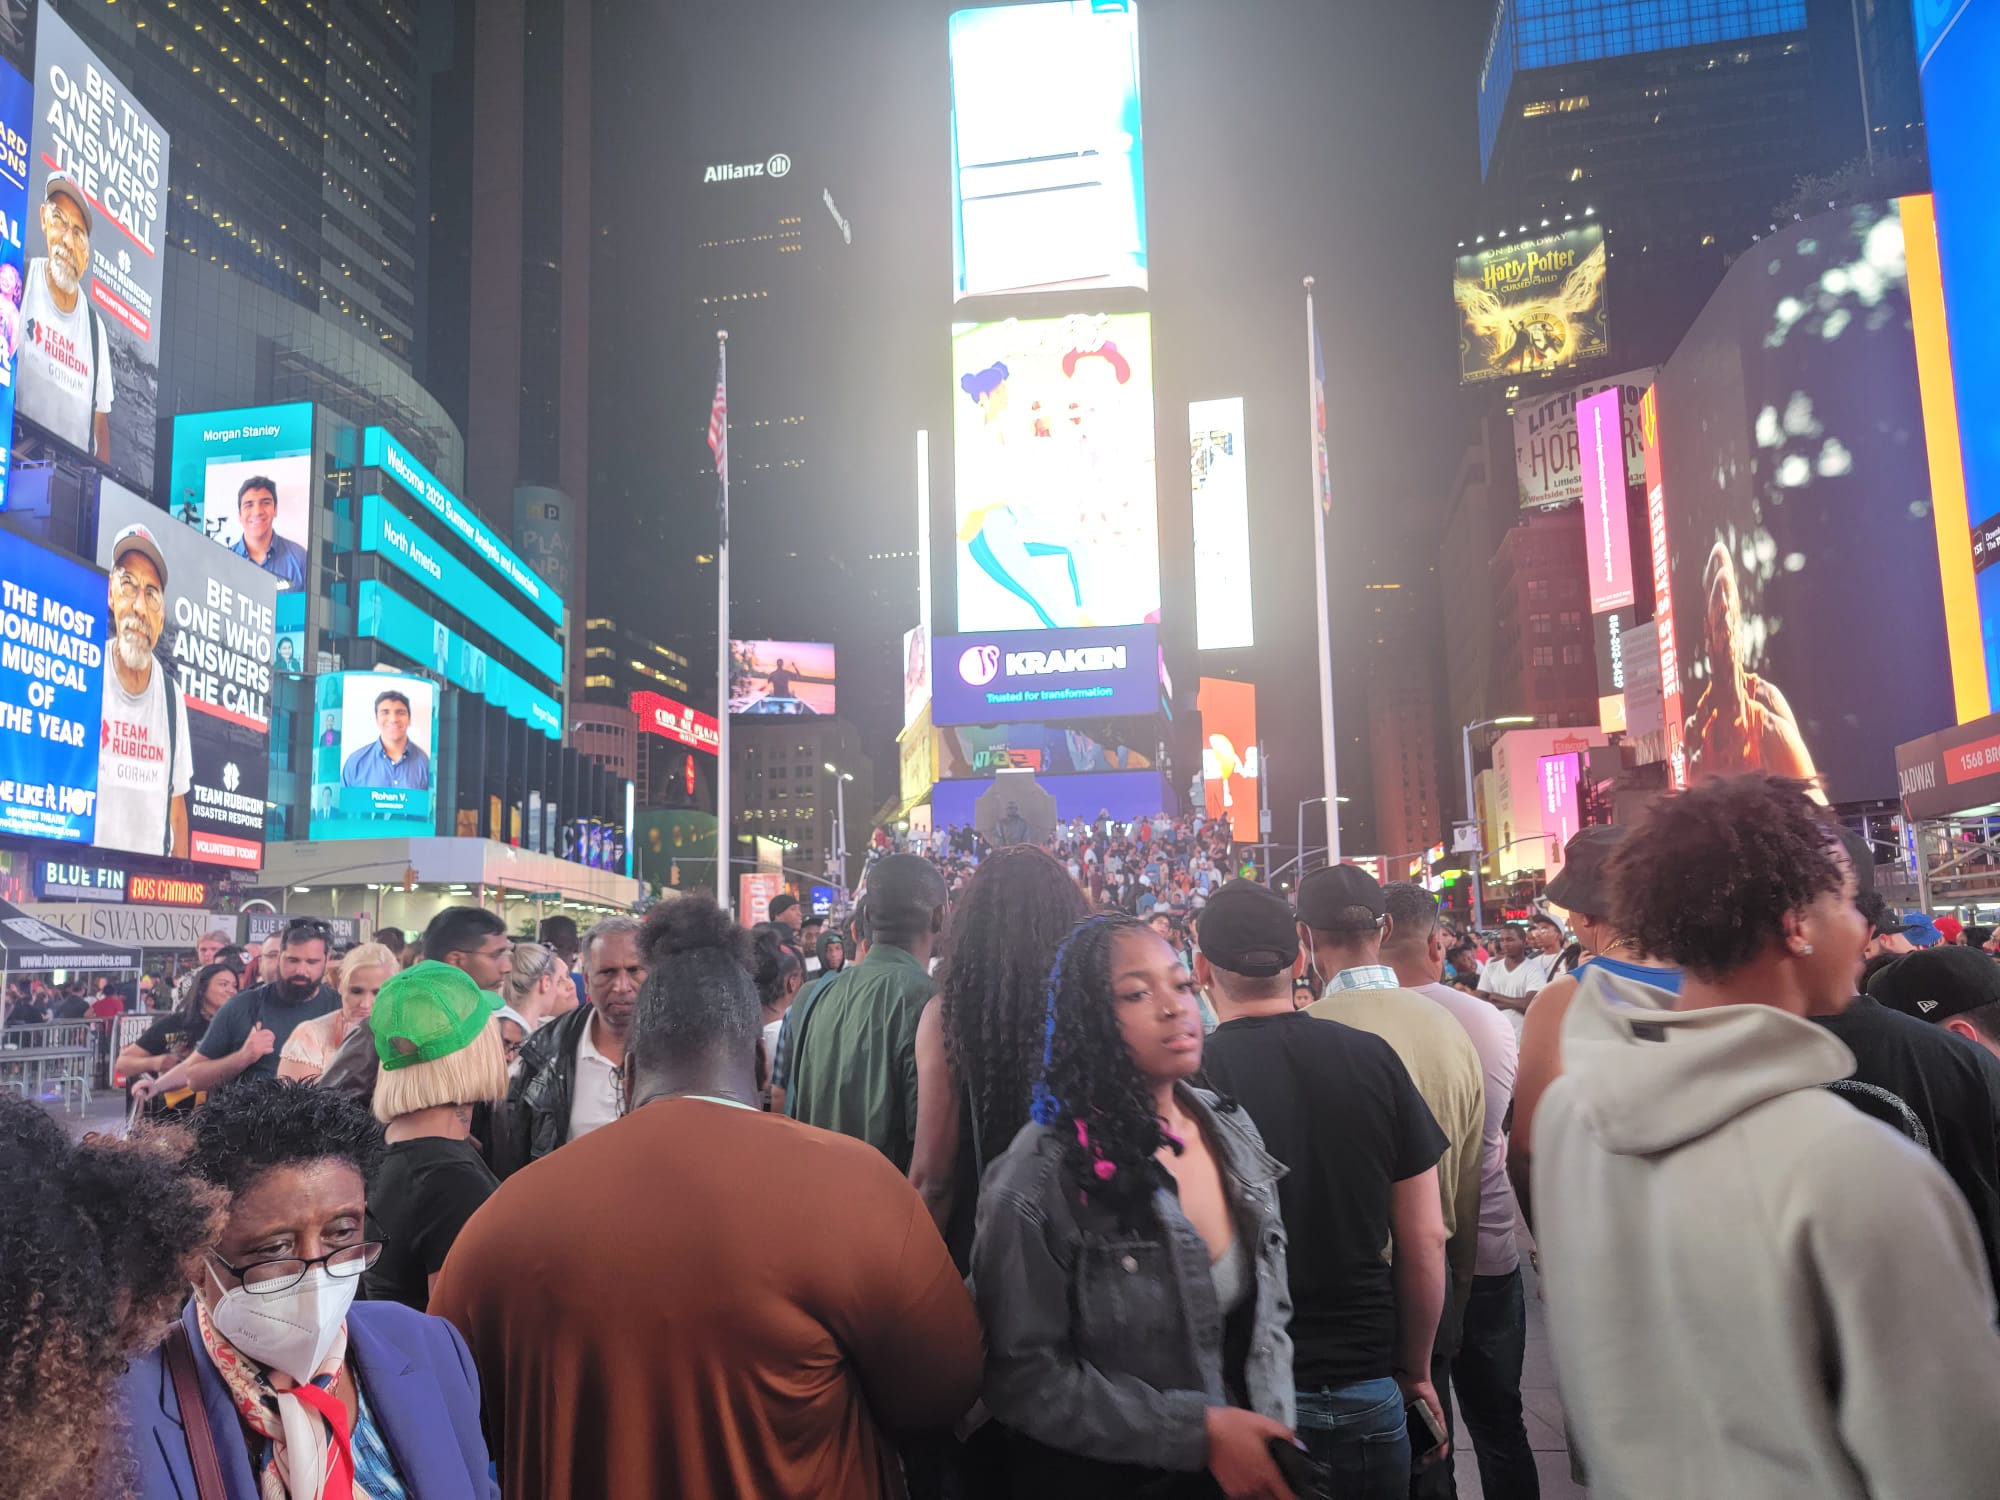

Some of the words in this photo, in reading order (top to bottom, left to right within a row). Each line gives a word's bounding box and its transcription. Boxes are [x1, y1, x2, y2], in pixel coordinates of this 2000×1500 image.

[50, 65, 101, 129] ONE
[107, 122, 159, 189] WHO
[86, 63, 116, 117] BE
[121, 100, 160, 163] THE
[47, 100, 157, 222] ANSWERS
[703, 161, 764, 184] Allianz
[52, 134, 98, 201] THE
[104, 189, 155, 258] CALL
[1487, 248, 1503, 259] ON
[1506, 232, 1569, 254] BROADWAY
[92, 262, 122, 294] DISASTER
[94, 249, 118, 280] TEAM
[118, 269, 152, 308] RUBICON
[1482, 259, 1526, 290] Harry
[1526, 249, 1575, 282] Potter
[1501, 279, 1531, 293] CURSED
[1532, 274, 1558, 286] CHILD
[95, 286, 129, 320] VOLUNTEER
[128, 311, 148, 334] TODAY
[45, 325, 75, 355] TEAM
[44, 339, 89, 377] RUBICON
[203, 427, 241, 445] Morgan
[242, 423, 281, 440] Stanley
[387, 444, 425, 495] Welcome
[426, 481, 445, 514] 2023
[445, 499, 475, 541] Summer
[1528, 489, 1563, 504] Westside
[384, 518, 410, 556] North
[409, 540, 442, 580] America
[522, 530, 570, 559] PLAY
[1649, 483, 1671, 617] HERSHEY'S
[2, 580, 37, 617] THE
[42, 597, 95, 639] MOST
[207, 577, 233, 616] BE
[238, 592, 272, 635] THE
[174, 596, 221, 642] ONE
[225, 618, 270, 664] WHO
[2, 641, 87, 692] MUSICAL
[172, 630, 269, 694] ANSWERS
[1005, 645, 1127, 676] KRAKEN
[1658, 617, 1677, 700] STORE
[27, 681, 55, 711] OF
[177, 664, 219, 706] THE
[222, 683, 268, 724] CALL
[986, 691, 1023, 704] Trusted
[1024, 689, 1039, 701] for
[1040, 686, 1114, 701] transformation
[0, 703, 32, 735] THE
[38, 713, 85, 748] YEAR
[114, 720, 147, 742] TEAM
[693, 723, 719, 742] PLAZA
[112, 737, 164, 762] RUBICON
[1960, 751, 1984, 771] 1568
[117, 763, 158, 784] GORHAM
[16, 782, 44, 807] LIKE
[59, 785, 96, 817] HOT
[194, 784, 224, 807] TEAM
[223, 791, 265, 816] RUBICON
[371, 790, 399, 802] Rohan
[399, 791, 408, 802] V.
[192, 803, 228, 823] DISASTER
[228, 811, 264, 830] RESPONSE
[195, 839, 236, 858] VOLUNTEER
[236, 846, 258, 860] TODAY
[46, 862, 91, 887] BLUE
[97, 868, 125, 890] FIN
[132, 876, 155, 900] DOS
[157, 879, 204, 906] CAMINOS
[93, 909, 208, 943] SWAROVSKI
[251, 919, 276, 934] BLUE
